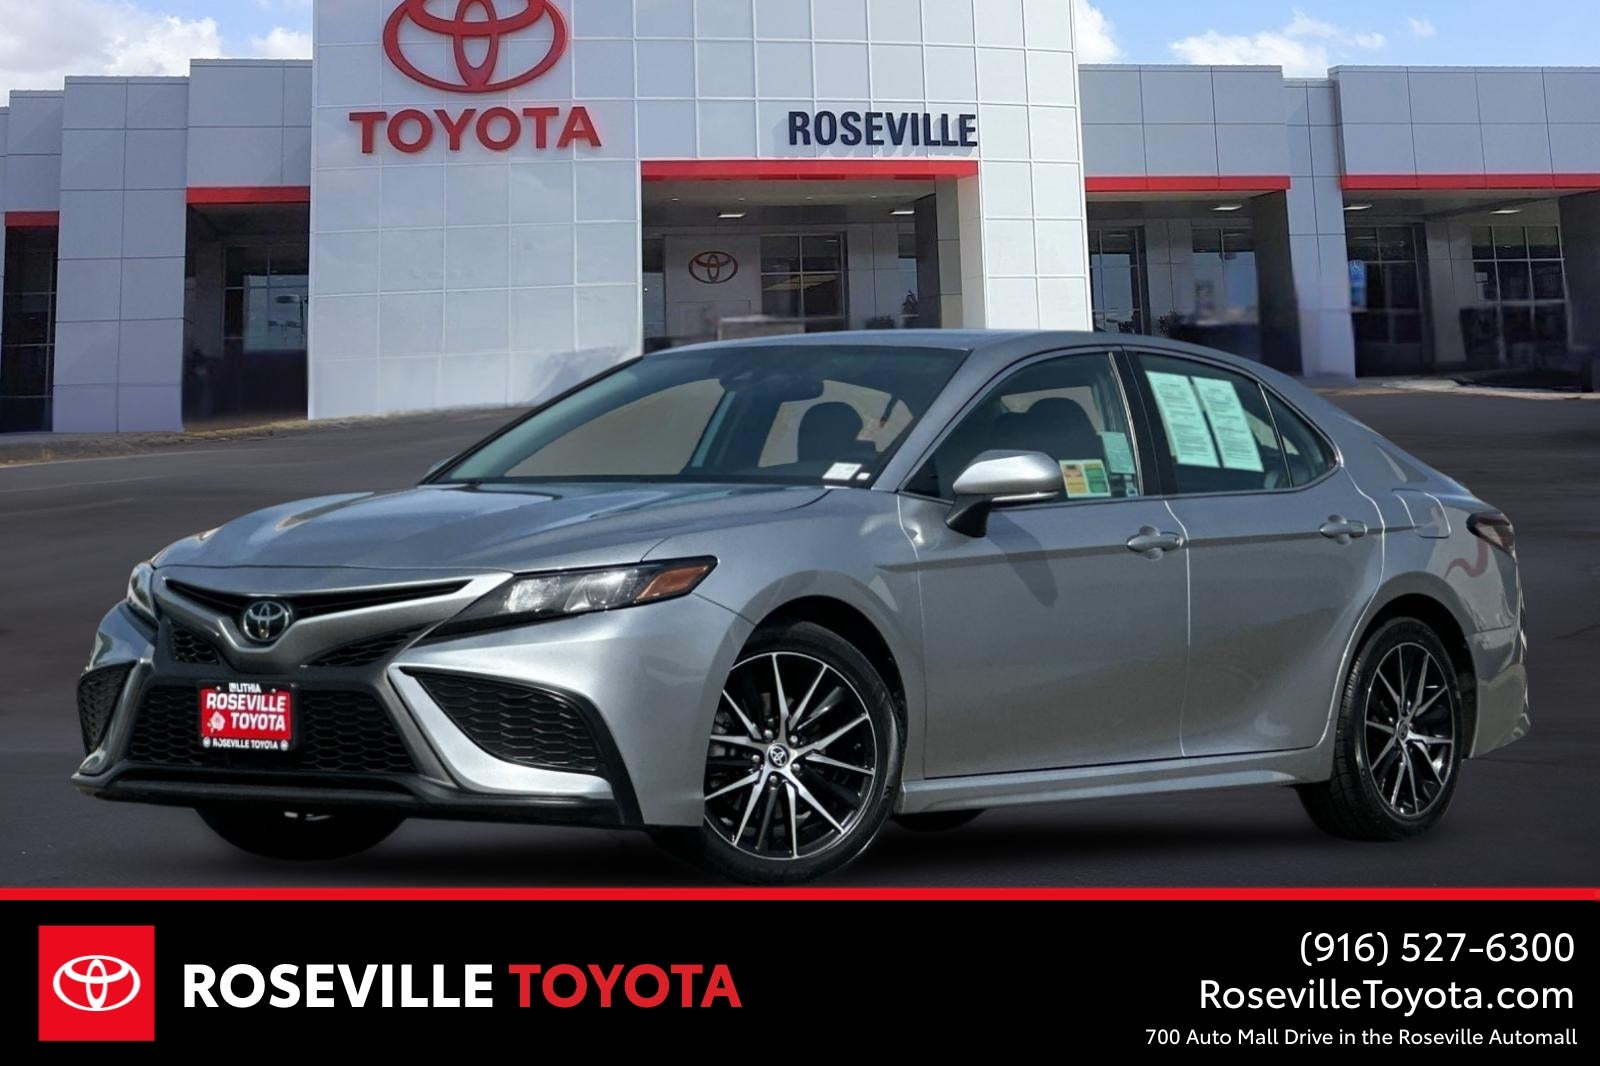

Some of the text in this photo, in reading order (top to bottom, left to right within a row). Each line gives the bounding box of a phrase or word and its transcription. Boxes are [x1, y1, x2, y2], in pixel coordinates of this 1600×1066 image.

[349, 106, 602, 154] TOYOTA
[788, 110, 978, 148] ROSEVILLE
[237, 683, 261, 693] LITHIA
[206, 693, 286, 712] ROSEVILLE
[231, 712, 286, 731] TOYOTA
[213, 738, 278, 749] ROSEVILLE TOYOTA
